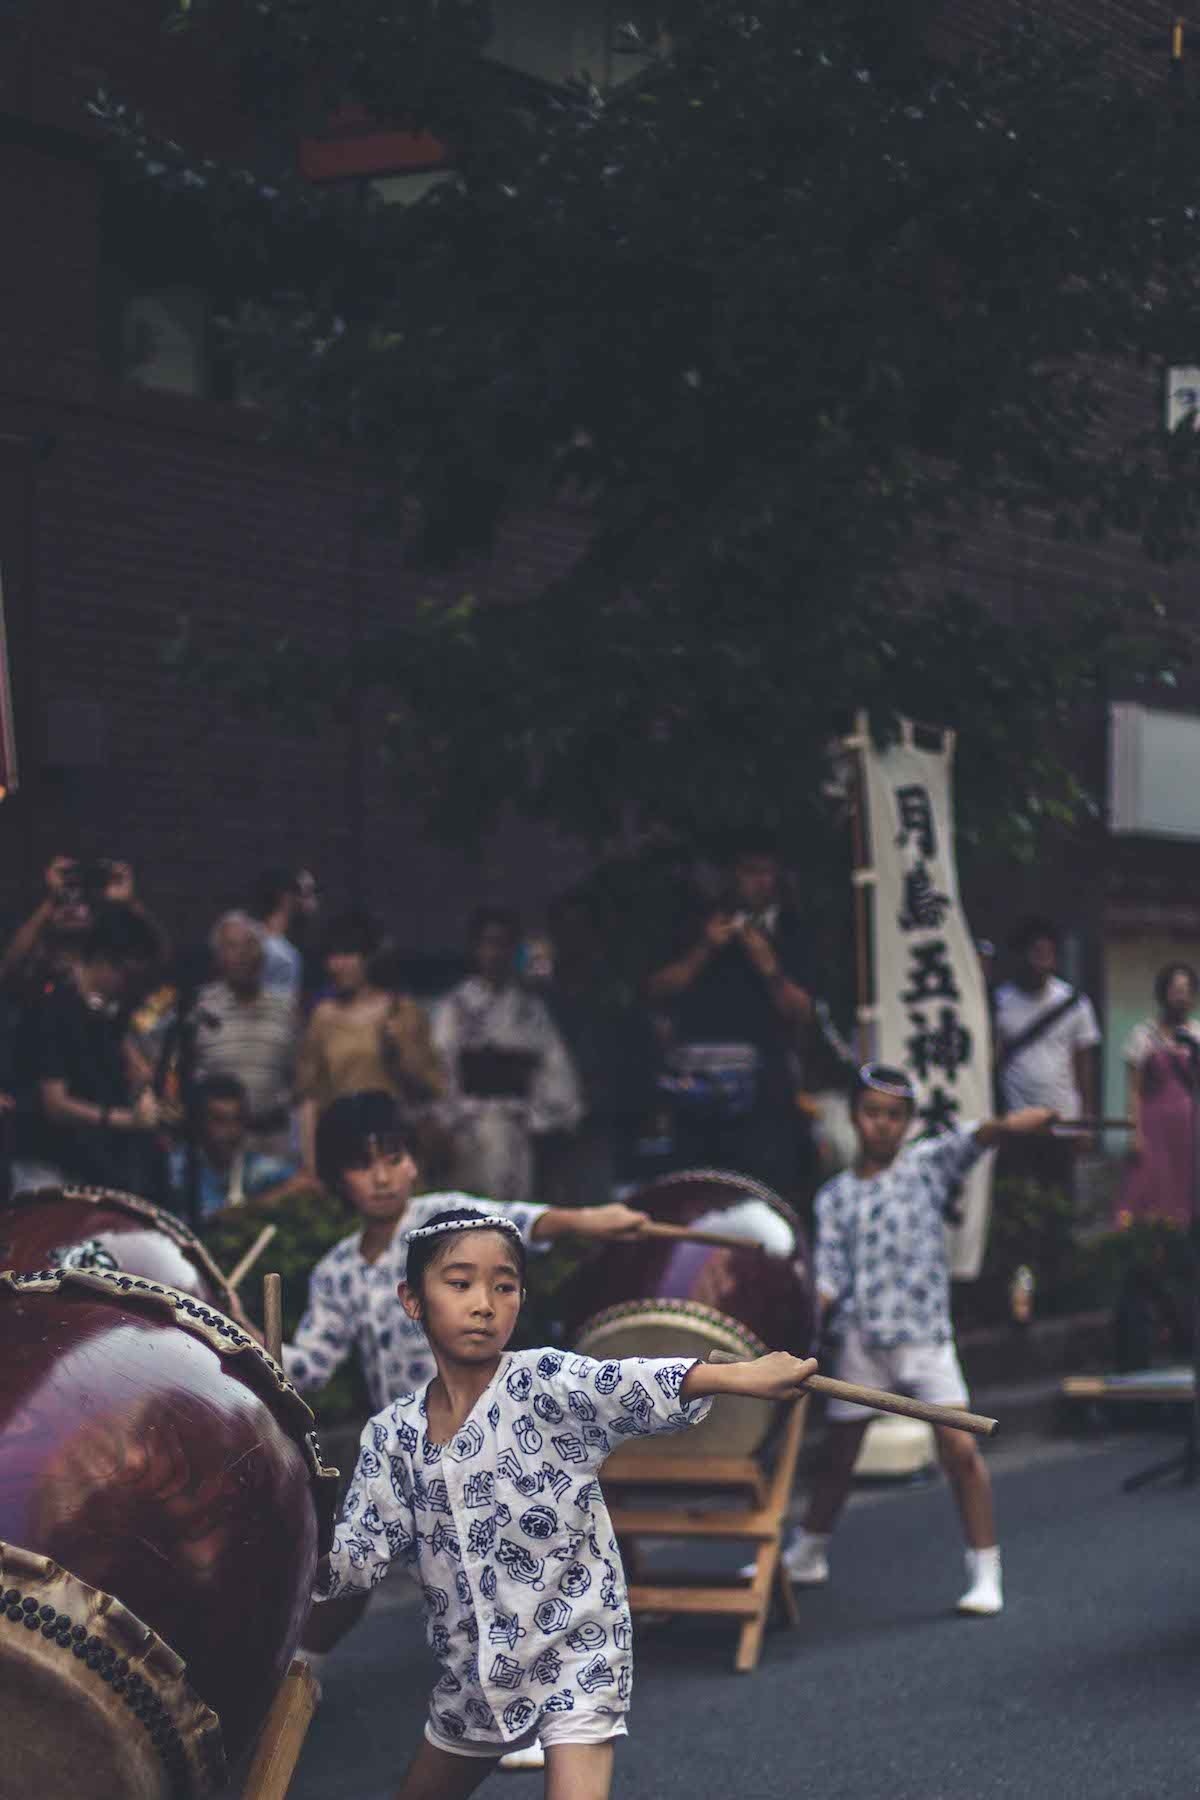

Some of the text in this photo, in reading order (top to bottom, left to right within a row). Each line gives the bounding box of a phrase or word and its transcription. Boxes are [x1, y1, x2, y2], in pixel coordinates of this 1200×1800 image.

[896, 783, 973, 1228] 月島五神太
